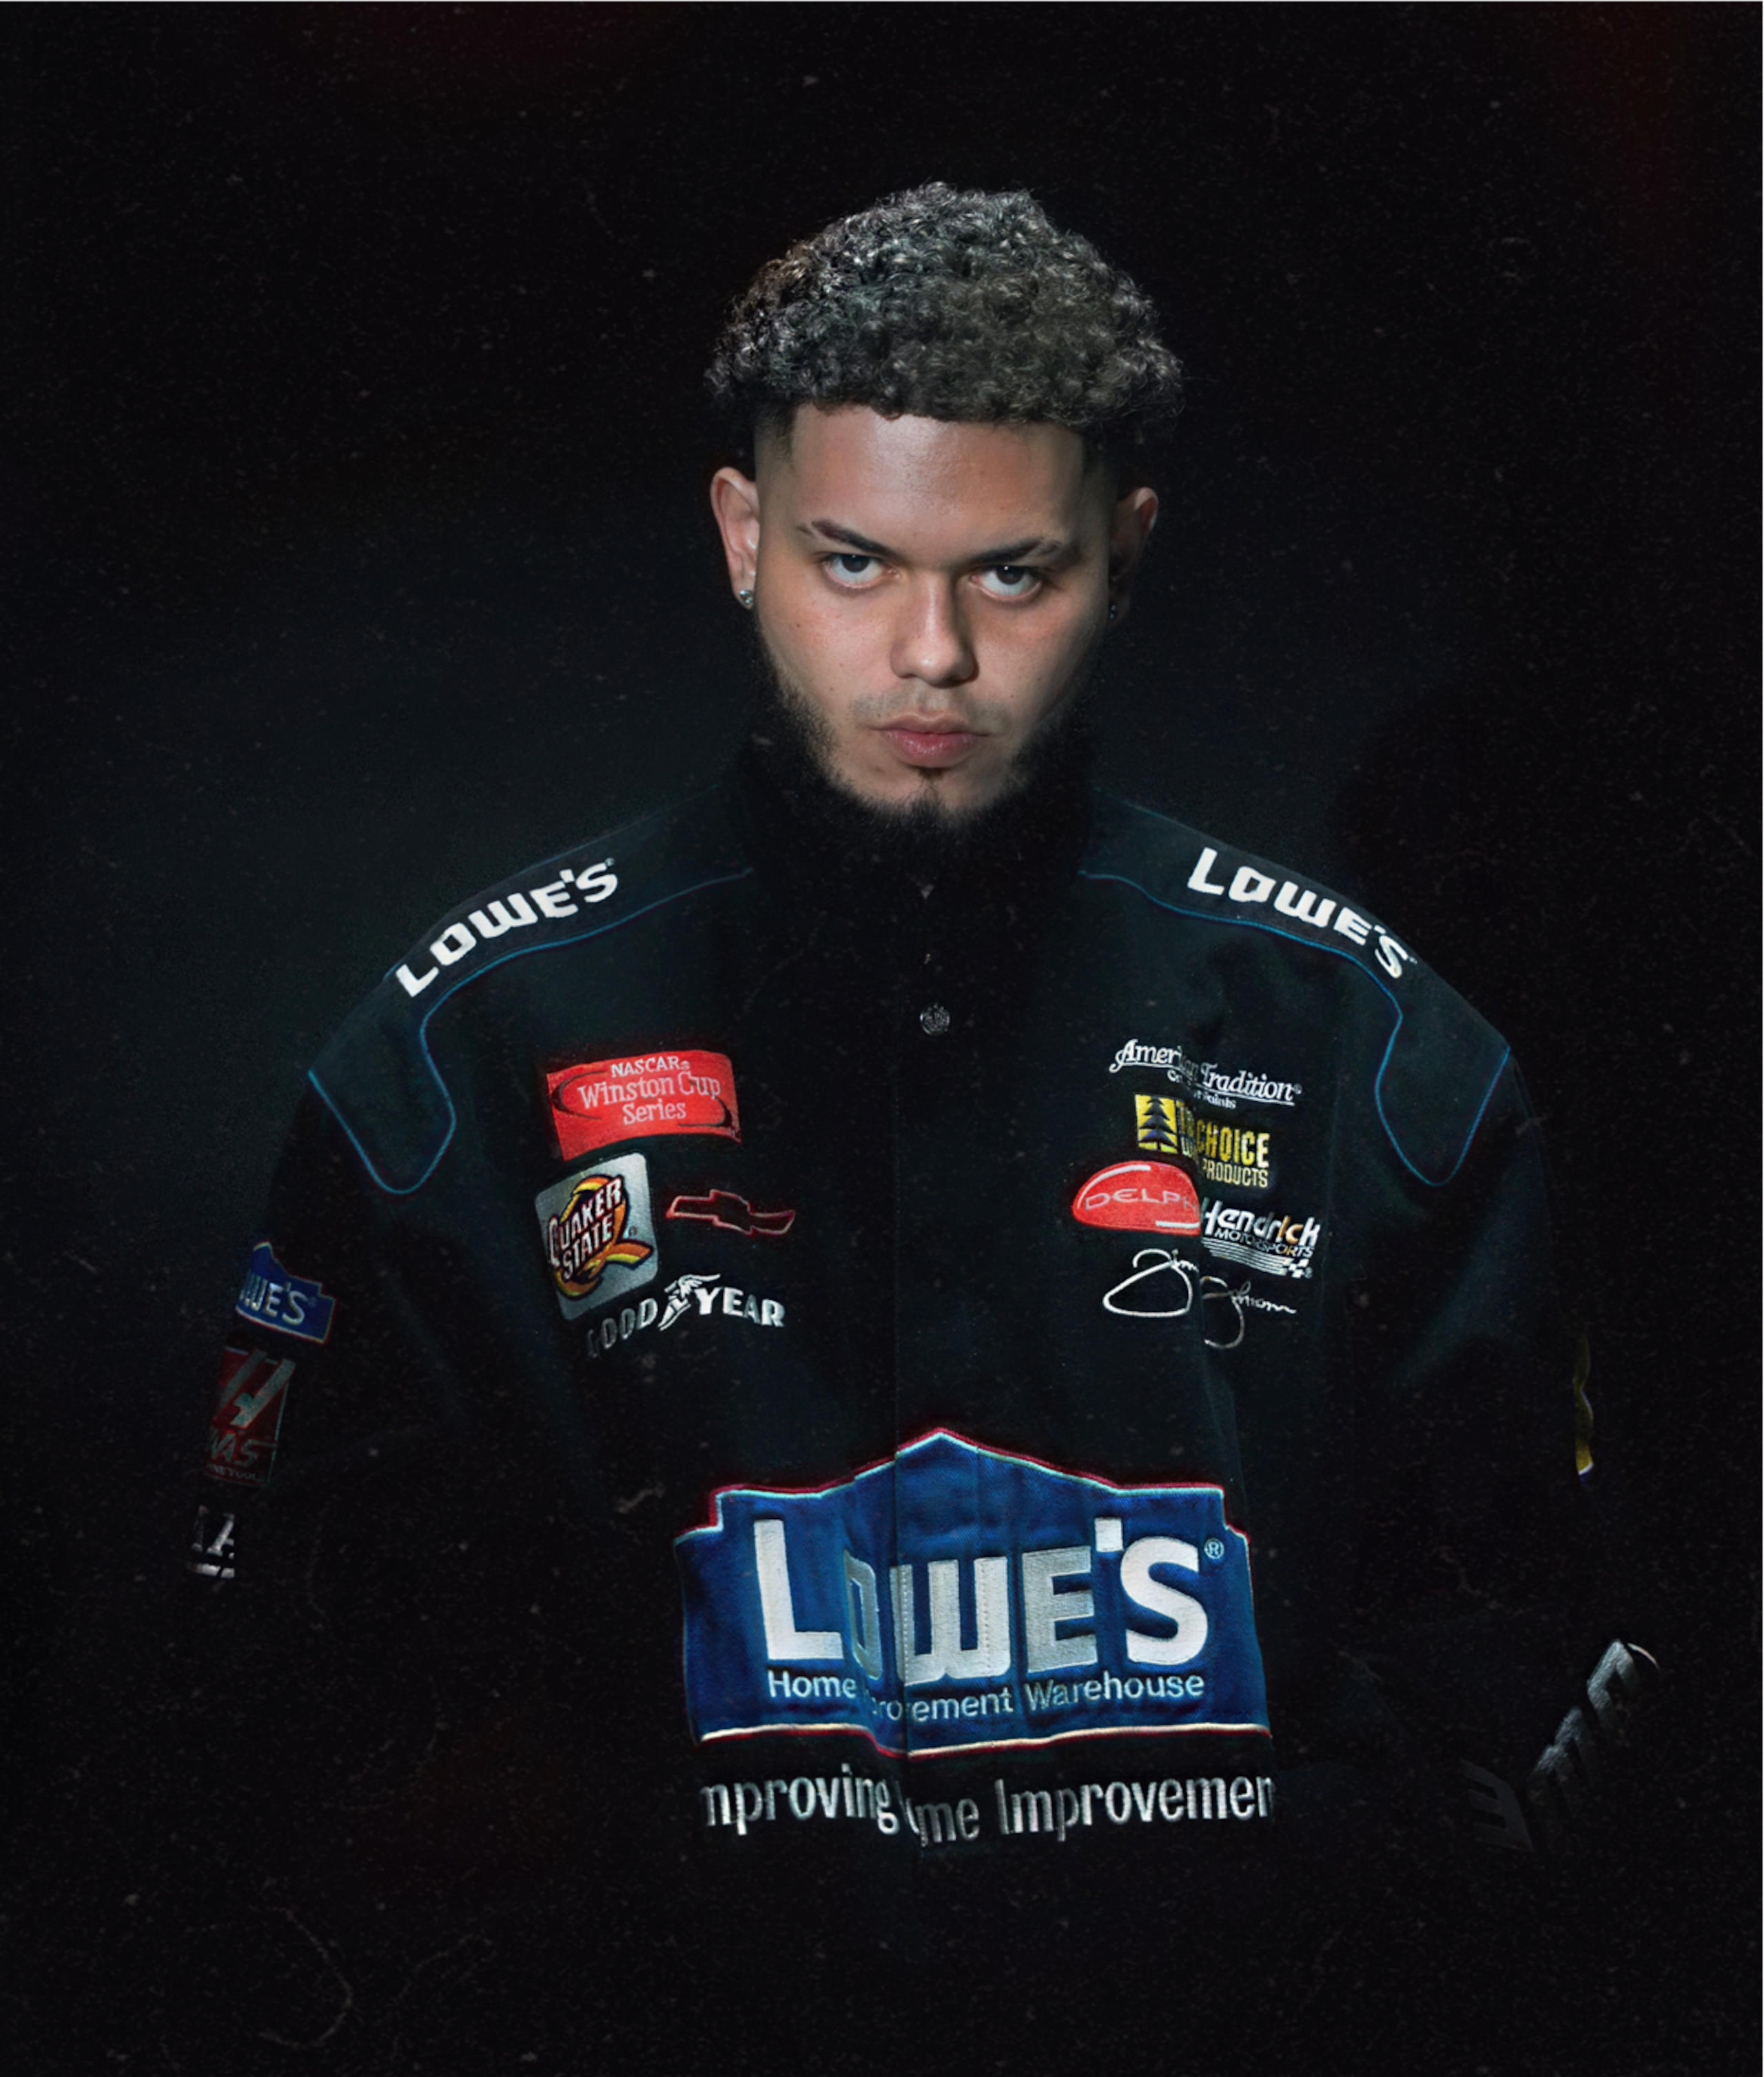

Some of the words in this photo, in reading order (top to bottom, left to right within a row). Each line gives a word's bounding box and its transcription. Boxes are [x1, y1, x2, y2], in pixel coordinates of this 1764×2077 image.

[395, 861, 618, 998] LOWE'S
[1187, 846, 1408, 979] LOWE'S
[577, 1075, 677, 1109] Winston
[677, 1071, 722, 1100] Cup
[610, 1055, 681, 1078] NASCAR
[1200, 1062, 1295, 1105] Tradition
[622, 1098, 687, 1125] Series
[1196, 1118, 1271, 1168] CHOICE
[548, 1175, 623, 1269] QUAKER
[1084, 1187, 1198, 1211] DELPH
[1200, 1196, 1321, 1247] Hendrick
[561, 1211, 614, 1282] STATE
[752, 1517, 1209, 1686] LOWE'S
[768, 1669, 857, 1699] Home
[1024, 1670, 1205, 1712] Warehouse
[700, 1762, 899, 1836] mproving
[993, 1776, 1276, 1843] Improvemen
